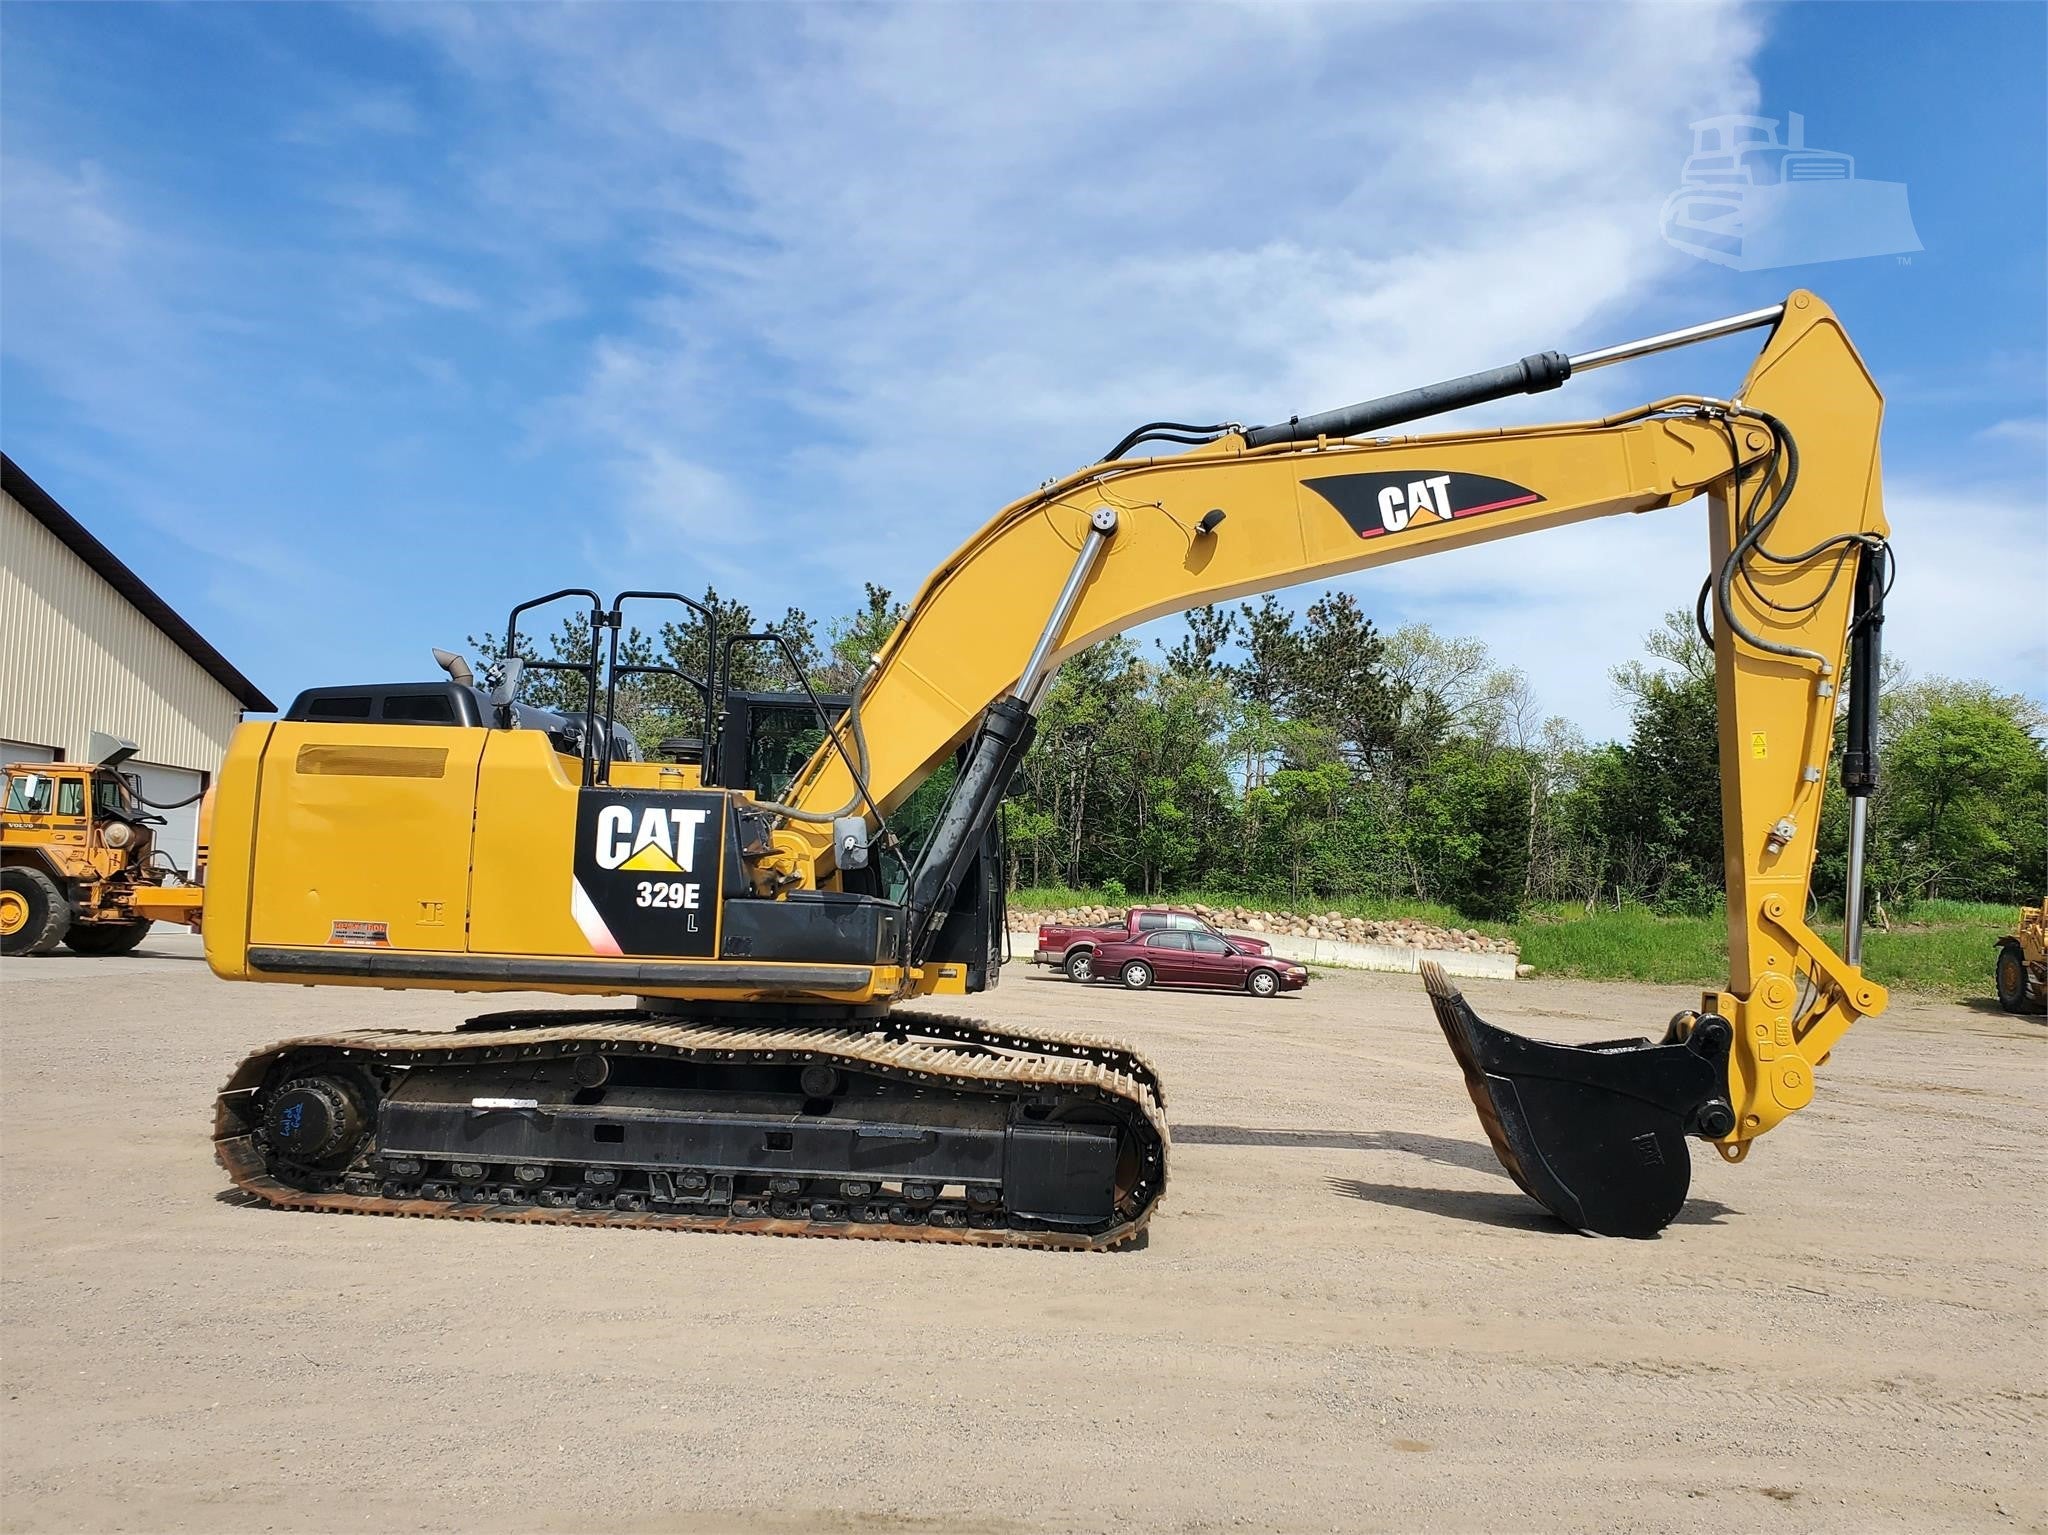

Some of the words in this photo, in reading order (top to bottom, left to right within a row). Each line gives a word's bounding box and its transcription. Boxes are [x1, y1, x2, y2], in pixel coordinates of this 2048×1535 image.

[1378, 475, 1453, 532] CAT
[596, 805, 706, 873] CAT
[636, 881, 700, 909] 329E
[687, 913, 698, 932] L
